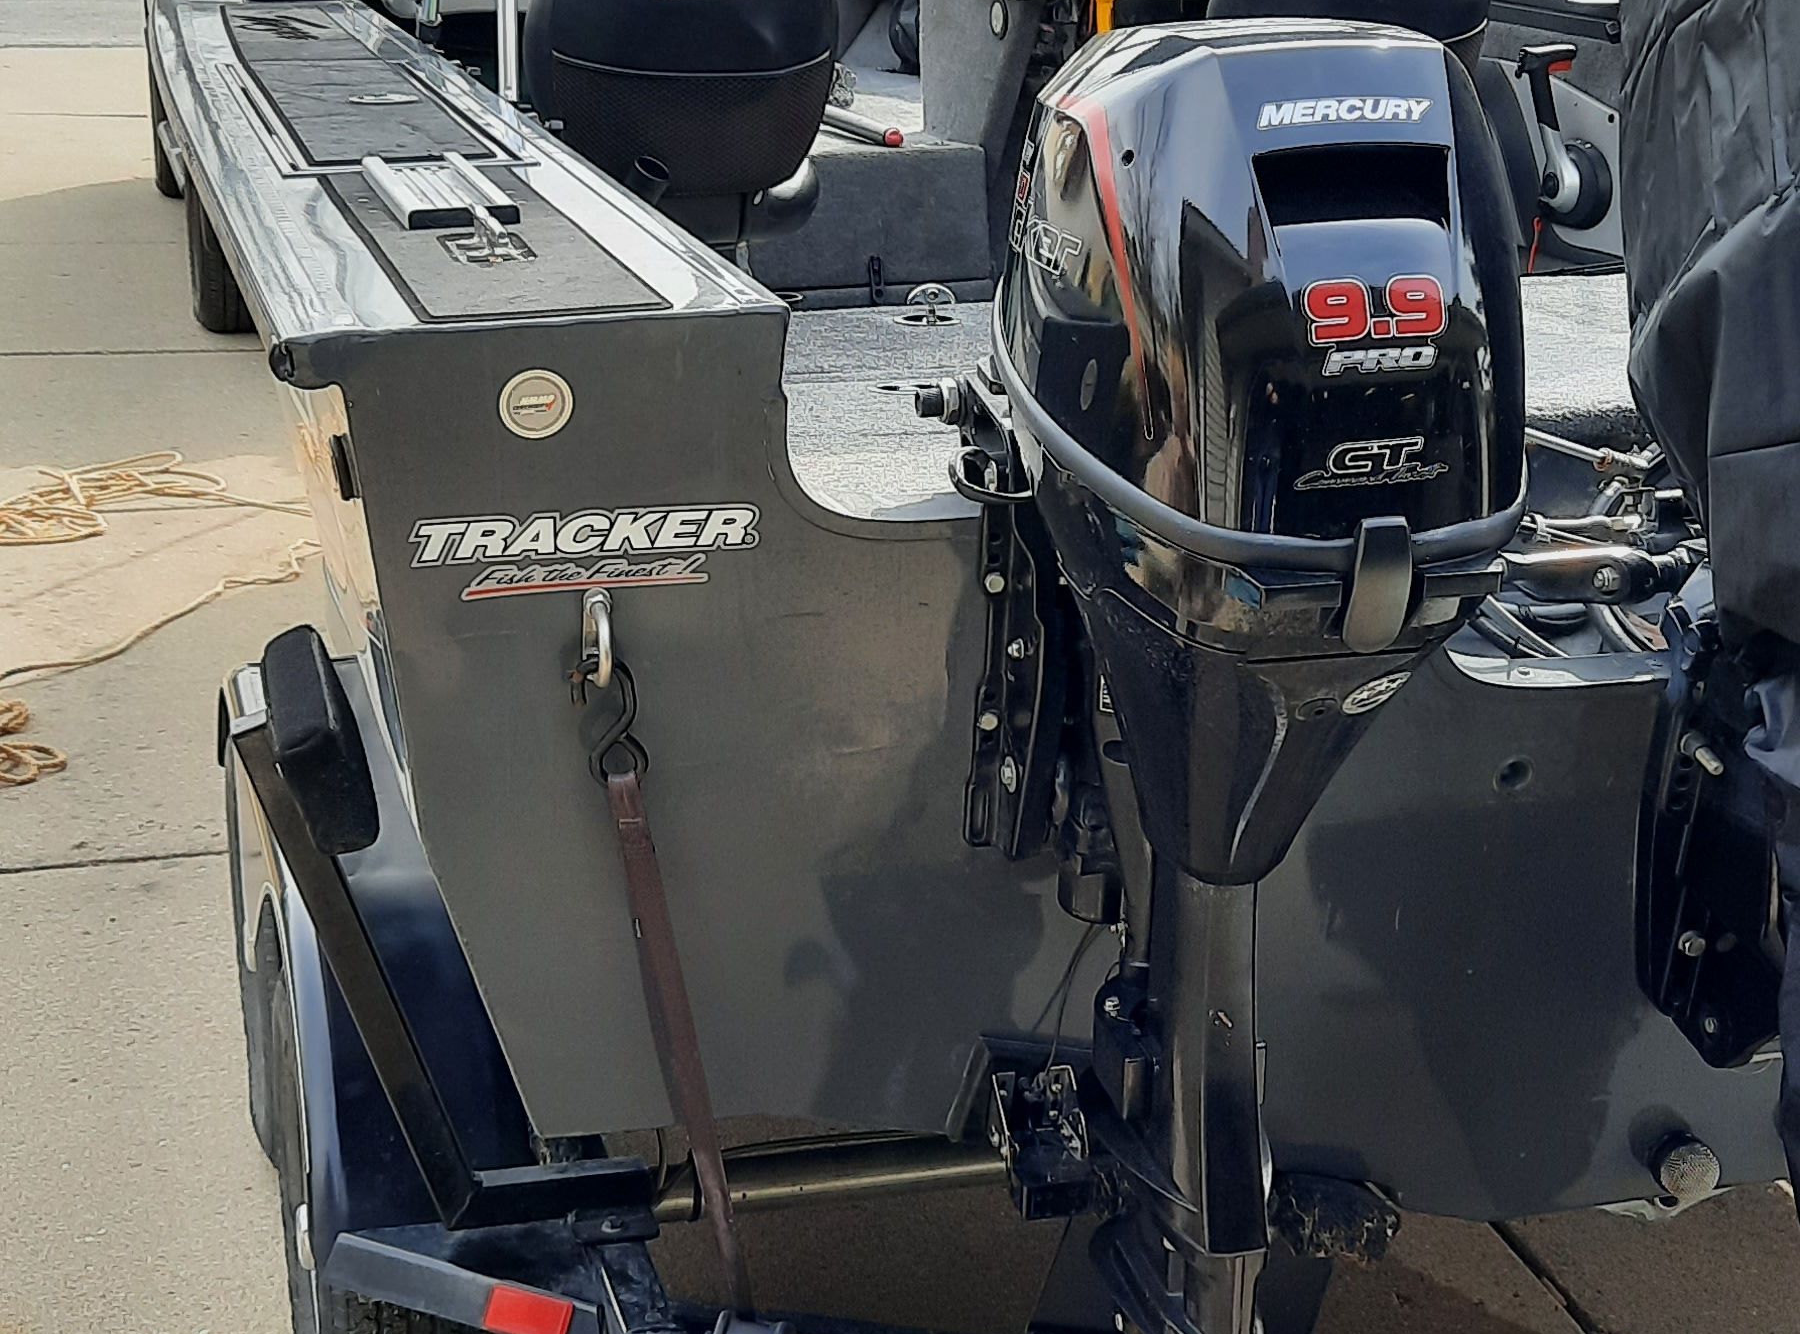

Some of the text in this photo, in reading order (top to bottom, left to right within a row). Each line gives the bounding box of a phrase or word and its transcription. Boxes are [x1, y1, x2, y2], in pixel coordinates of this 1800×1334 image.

[1258, 98, 1433, 128] MERCURY
[1303, 274, 1448, 344] 9.9
[1324, 345, 1438, 375] PRO
[415, 508, 756, 563] TRACKER
[475, 566, 537, 587] Fish
[542, 566, 584, 582] the
